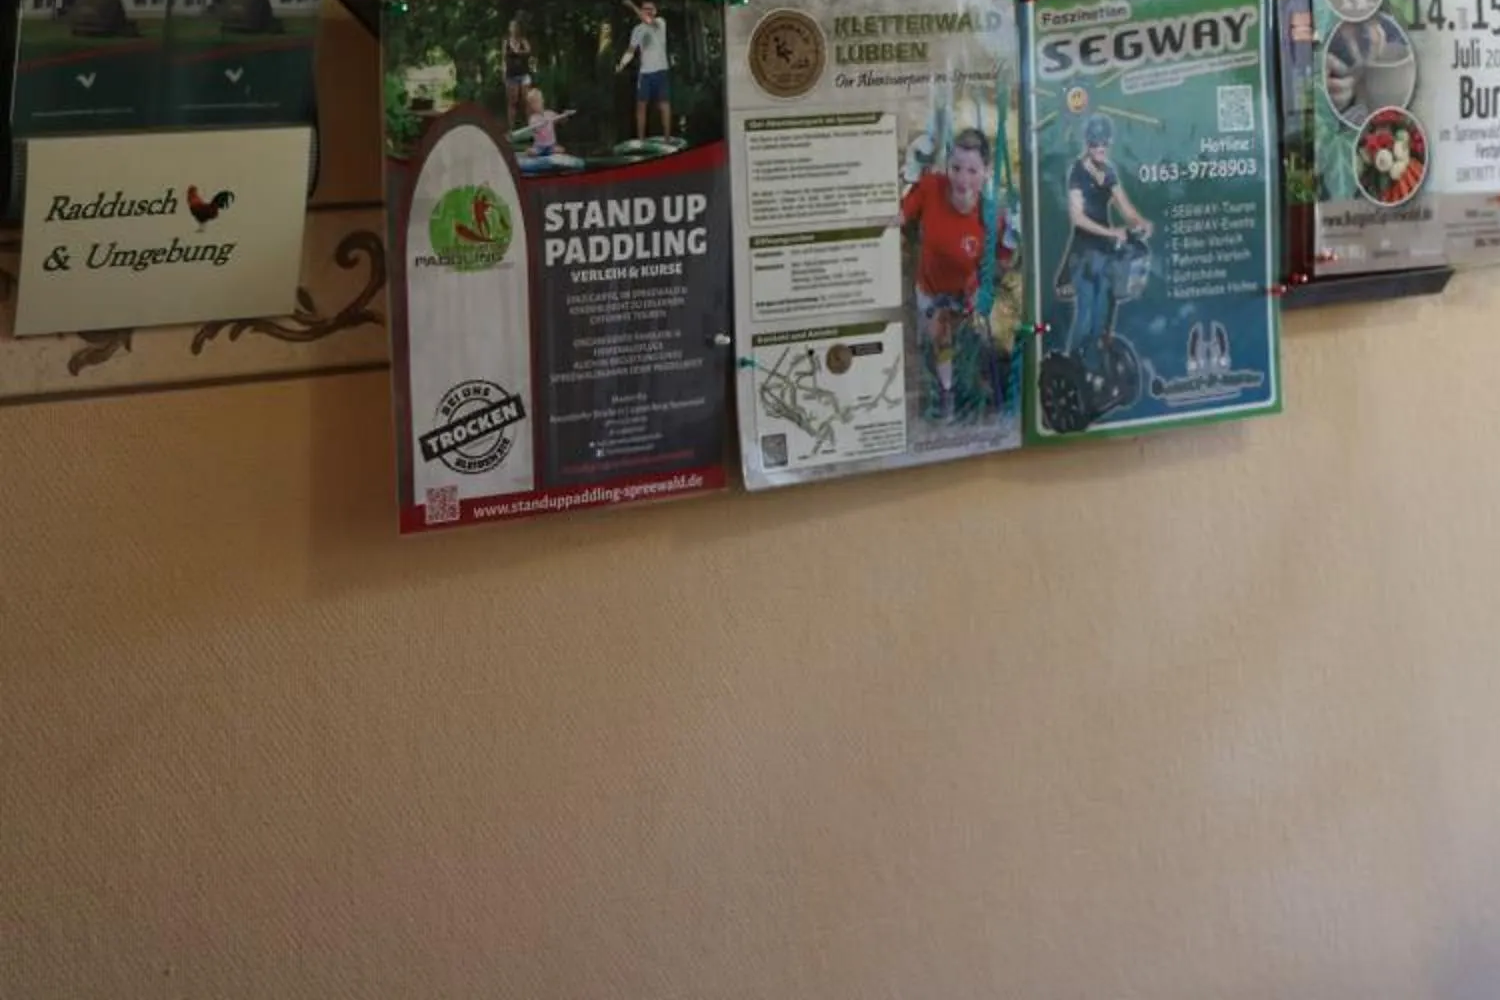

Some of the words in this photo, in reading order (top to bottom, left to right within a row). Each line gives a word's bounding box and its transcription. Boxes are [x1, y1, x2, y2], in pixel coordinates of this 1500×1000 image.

[835, 11, 1002, 37] KLETTERWALD
[1043, 13, 1247, 74] SEGWAY
[1452, 39, 1482, 70] Juli
[45, 188, 178, 222] Raddusch
[543, 198, 657, 233] STAND
[663, 194, 708, 224] UP
[42, 245, 70, 272] &
[85, 237, 237, 272] Umgebung
[543, 227, 708, 267] PADDLING
[570, 267, 627, 283] VERLEIH
[641, 263, 683, 278] KURSE
[427, 402, 518, 453] TROCKEN
[473, 474, 704, 519] www.standuppaddling-spreewald.de
